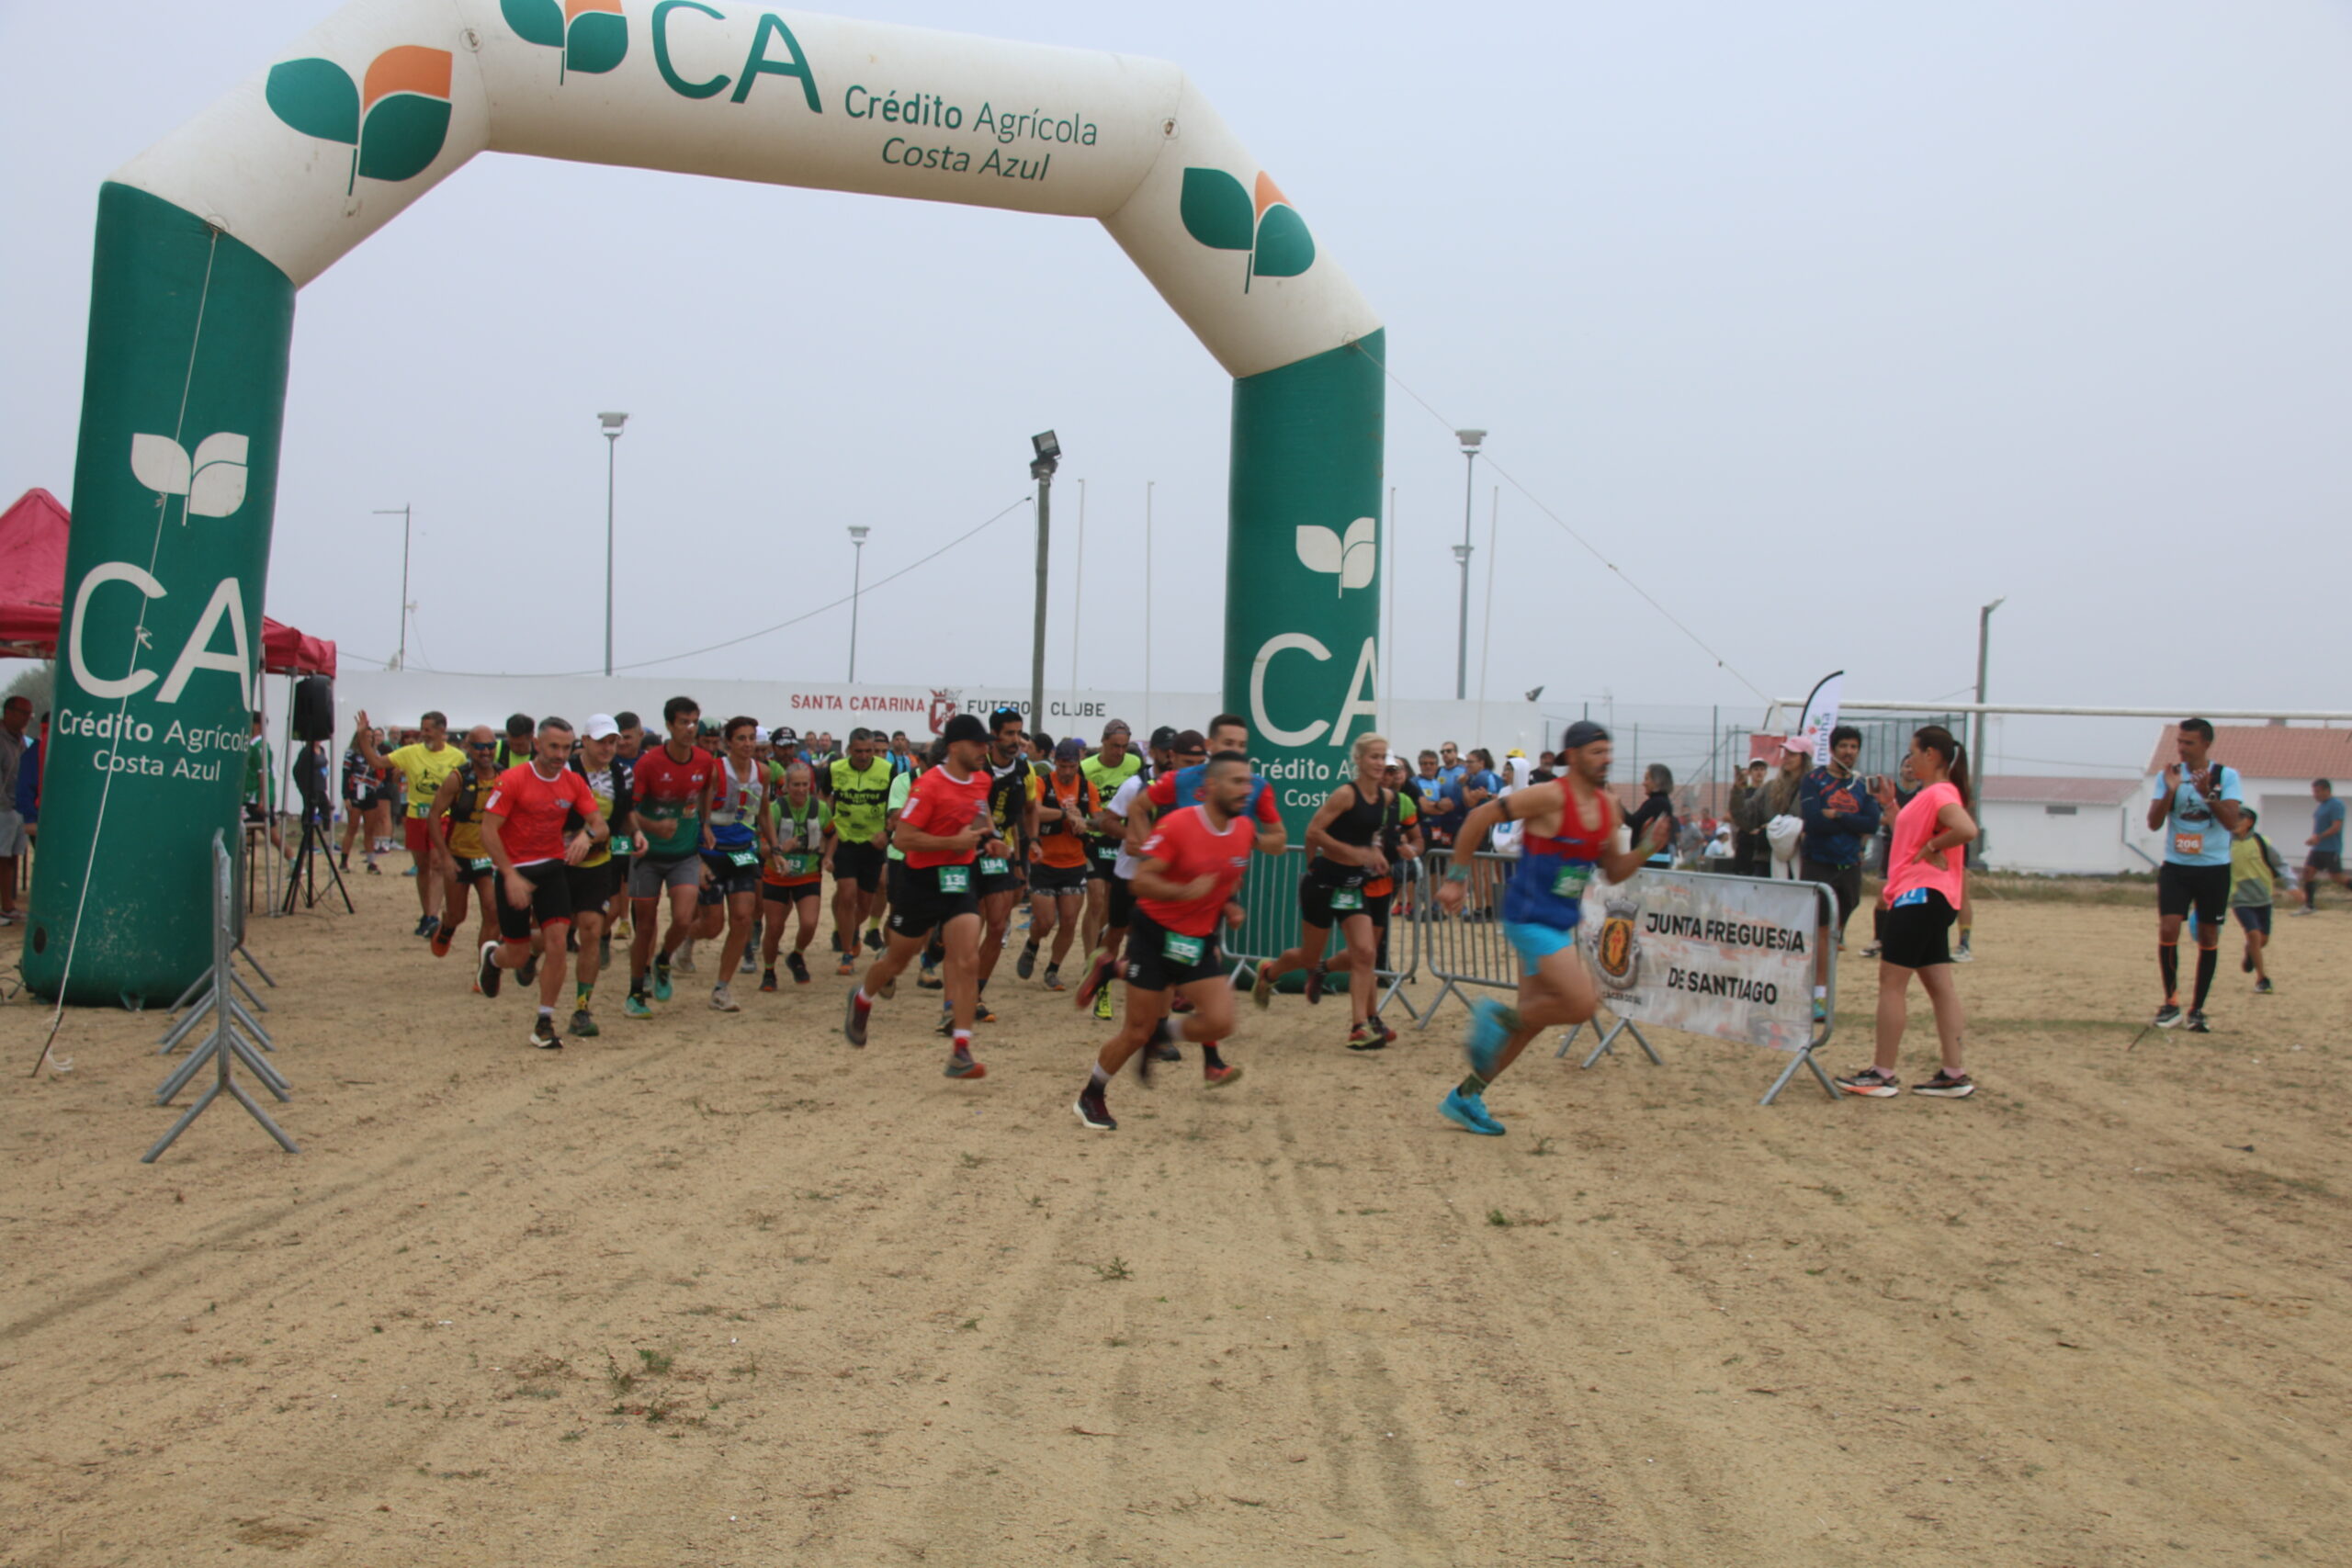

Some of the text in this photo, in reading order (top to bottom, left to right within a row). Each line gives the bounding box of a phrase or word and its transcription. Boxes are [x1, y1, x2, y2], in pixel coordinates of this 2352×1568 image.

[651, 1, 822, 114] CA
[844, 85, 1098, 145] Crédito Agrícola
[881, 138, 1051, 182] Costa Azul
[70, 561, 251, 713] CA
[791, 694, 1106, 716] SANTA CATARINA FUTEBO CLUBE
[1250, 632, 1378, 747] CA
[59, 708, 249, 752] Crédito Agrícola
[94, 750, 220, 781] Costa Azul
[1284, 788, 1334, 807] Cost
[1646, 913, 1804, 953] JUNTA FREGUESIA
[1668, 967, 1777, 1005] DE SANTIAGO
